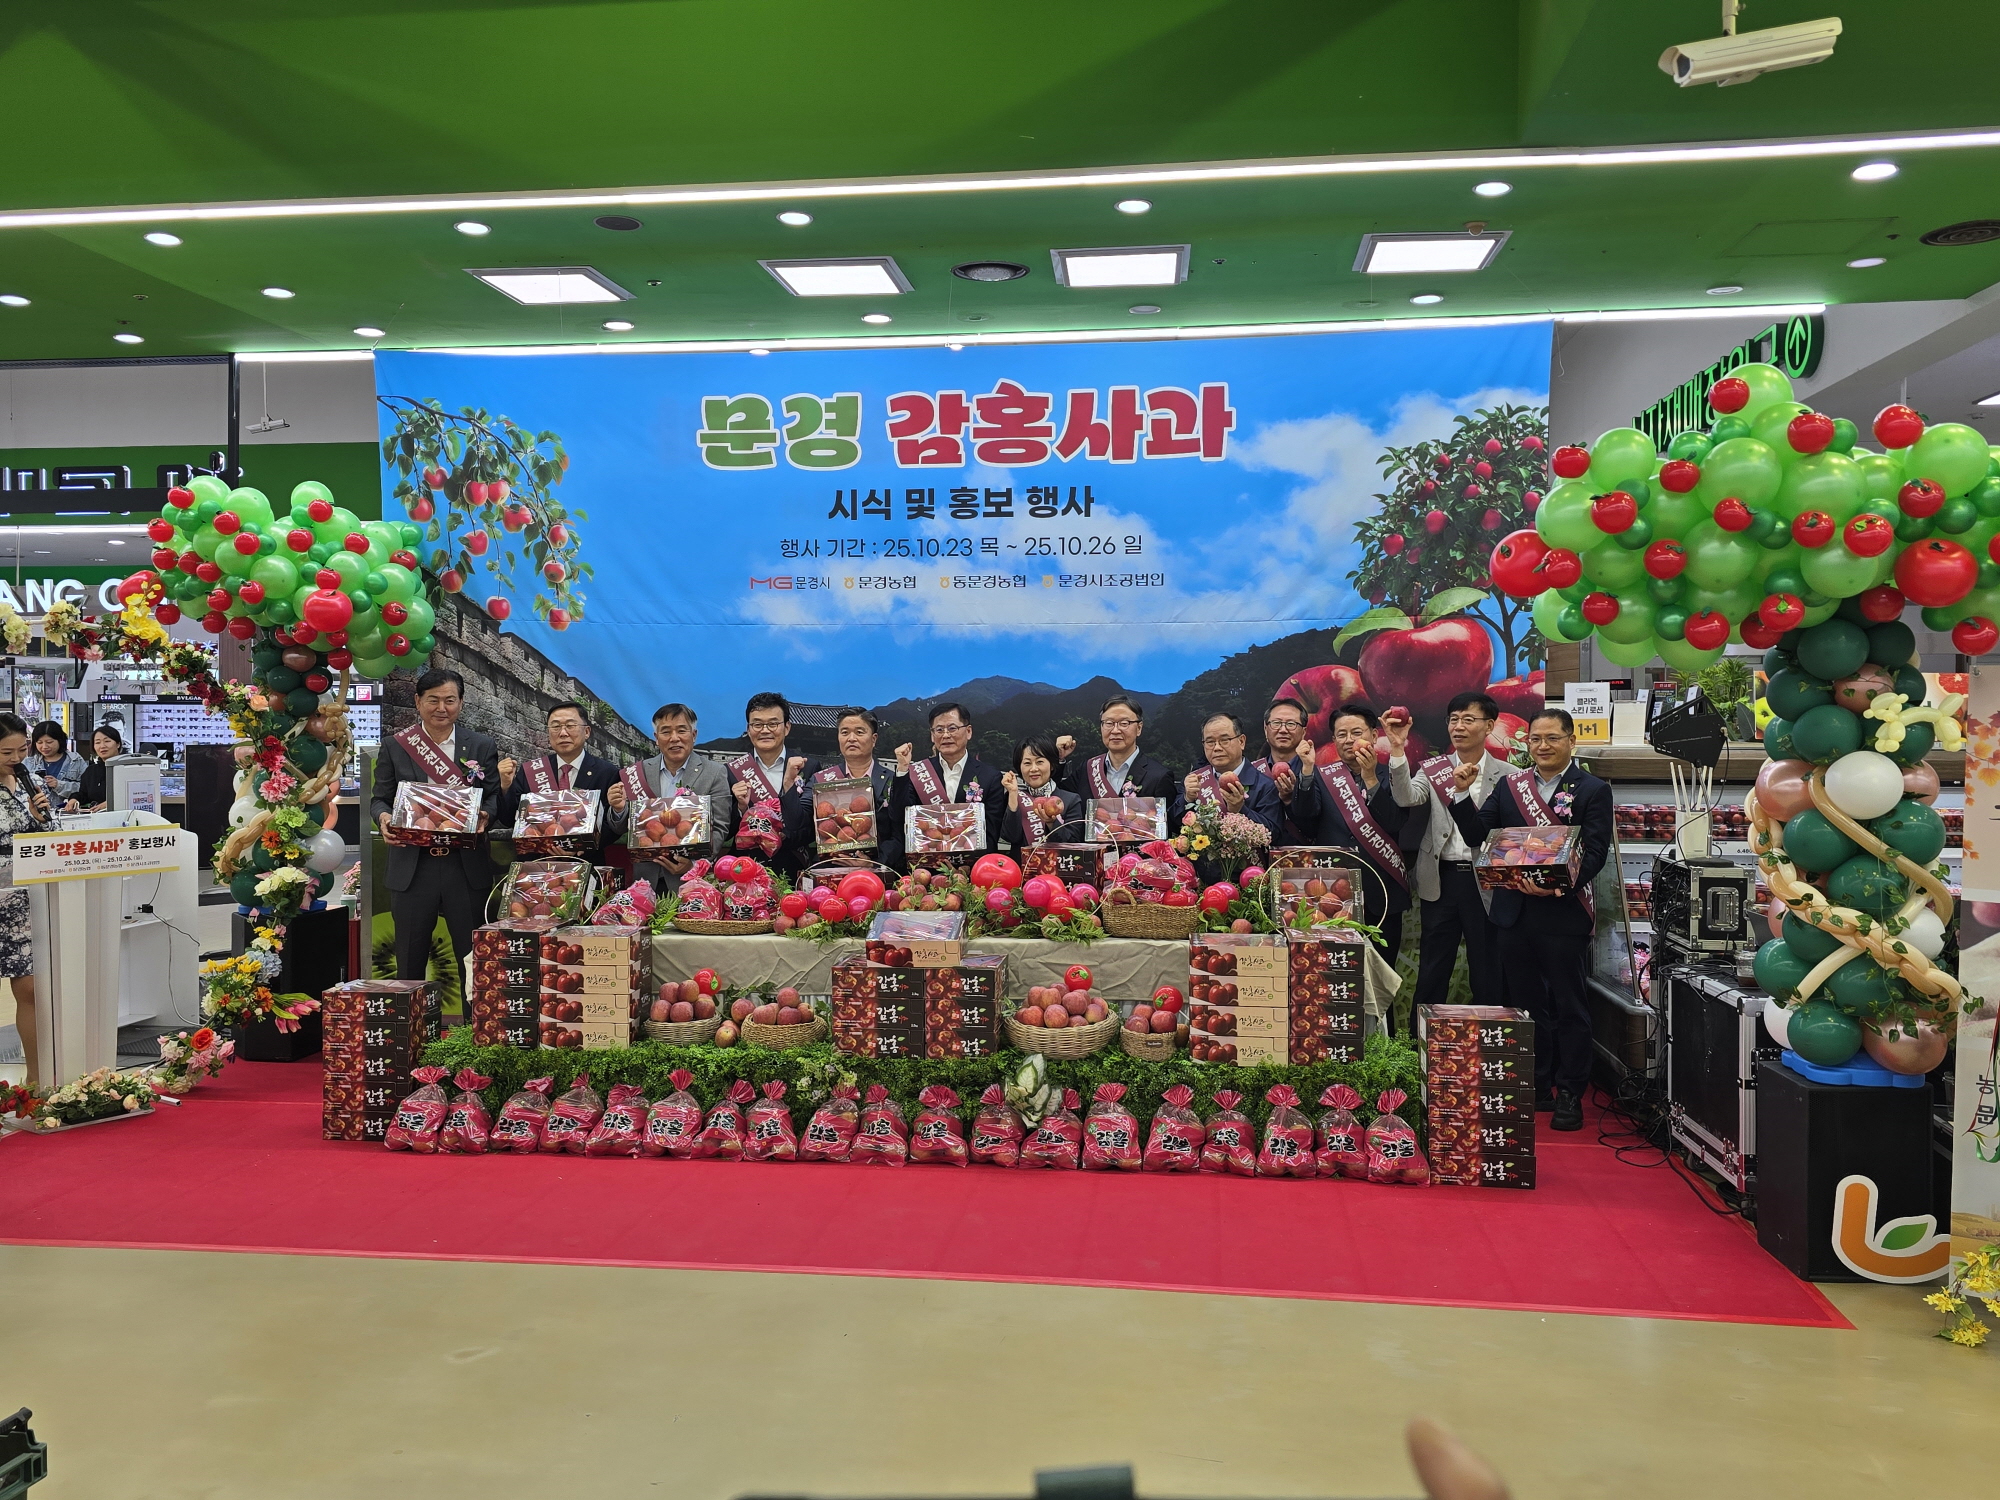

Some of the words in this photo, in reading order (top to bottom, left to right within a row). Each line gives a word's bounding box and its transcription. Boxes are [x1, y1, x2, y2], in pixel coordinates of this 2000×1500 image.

[697, 392, 862, 470] 문경
[886, 378, 1236, 468] 감홍사과
[828, 487, 893, 520] 시식
[904, 489, 936, 520] 및
[947, 486, 1014, 518] 홍보
[1025, 484, 1095, 517] 행사
[780, 538, 820, 558] 행사
[827, 538, 865, 558] 기간
[883, 538, 973, 558] 25.10.23
[980, 536, 999, 557] 목
[1024, 536, 1116, 556] 25.10.26
[1123, 534, 1142, 555] 일
[749, 576, 793, 590] MG
[795, 575, 831, 590] 문경시
[858, 574, 917, 590] 문경농협
[952, 573, 1027, 589] 동문경농협
[1058, 572, 1165, 589] 문경시조공법인
[1571, 706, 1585, 714] 스킨
[1589, 706, 1604, 714] 로션
[1578, 723, 1598, 736] 1+1
[407, 734, 449, 777] 농심천심
[1516, 780, 1552, 827] 농심천심
[1332, 776, 1365, 824] 농심천심
[1359, 823, 1407, 879] 문경감홍사
[19, 844, 46, 858] 문경
[128, 835, 176, 850] 홍보행사
[1057, 854, 1075, 871] 감홍
[1479, 1026, 1505, 1047] 감홍
[1480, 1060, 1506, 1080] 감홍
[1480, 1093, 1506, 1114] 감홍
[1095, 1130, 1129, 1148] 감홍
[1268, 1136, 1299, 1158] 감홍
[1326, 1134, 1358, 1153] 감홍
[1480, 1126, 1507, 1147] 감홍
[1381, 1138, 1415, 1160] 감홍
[1481, 1160, 1507, 1181] 감홍
